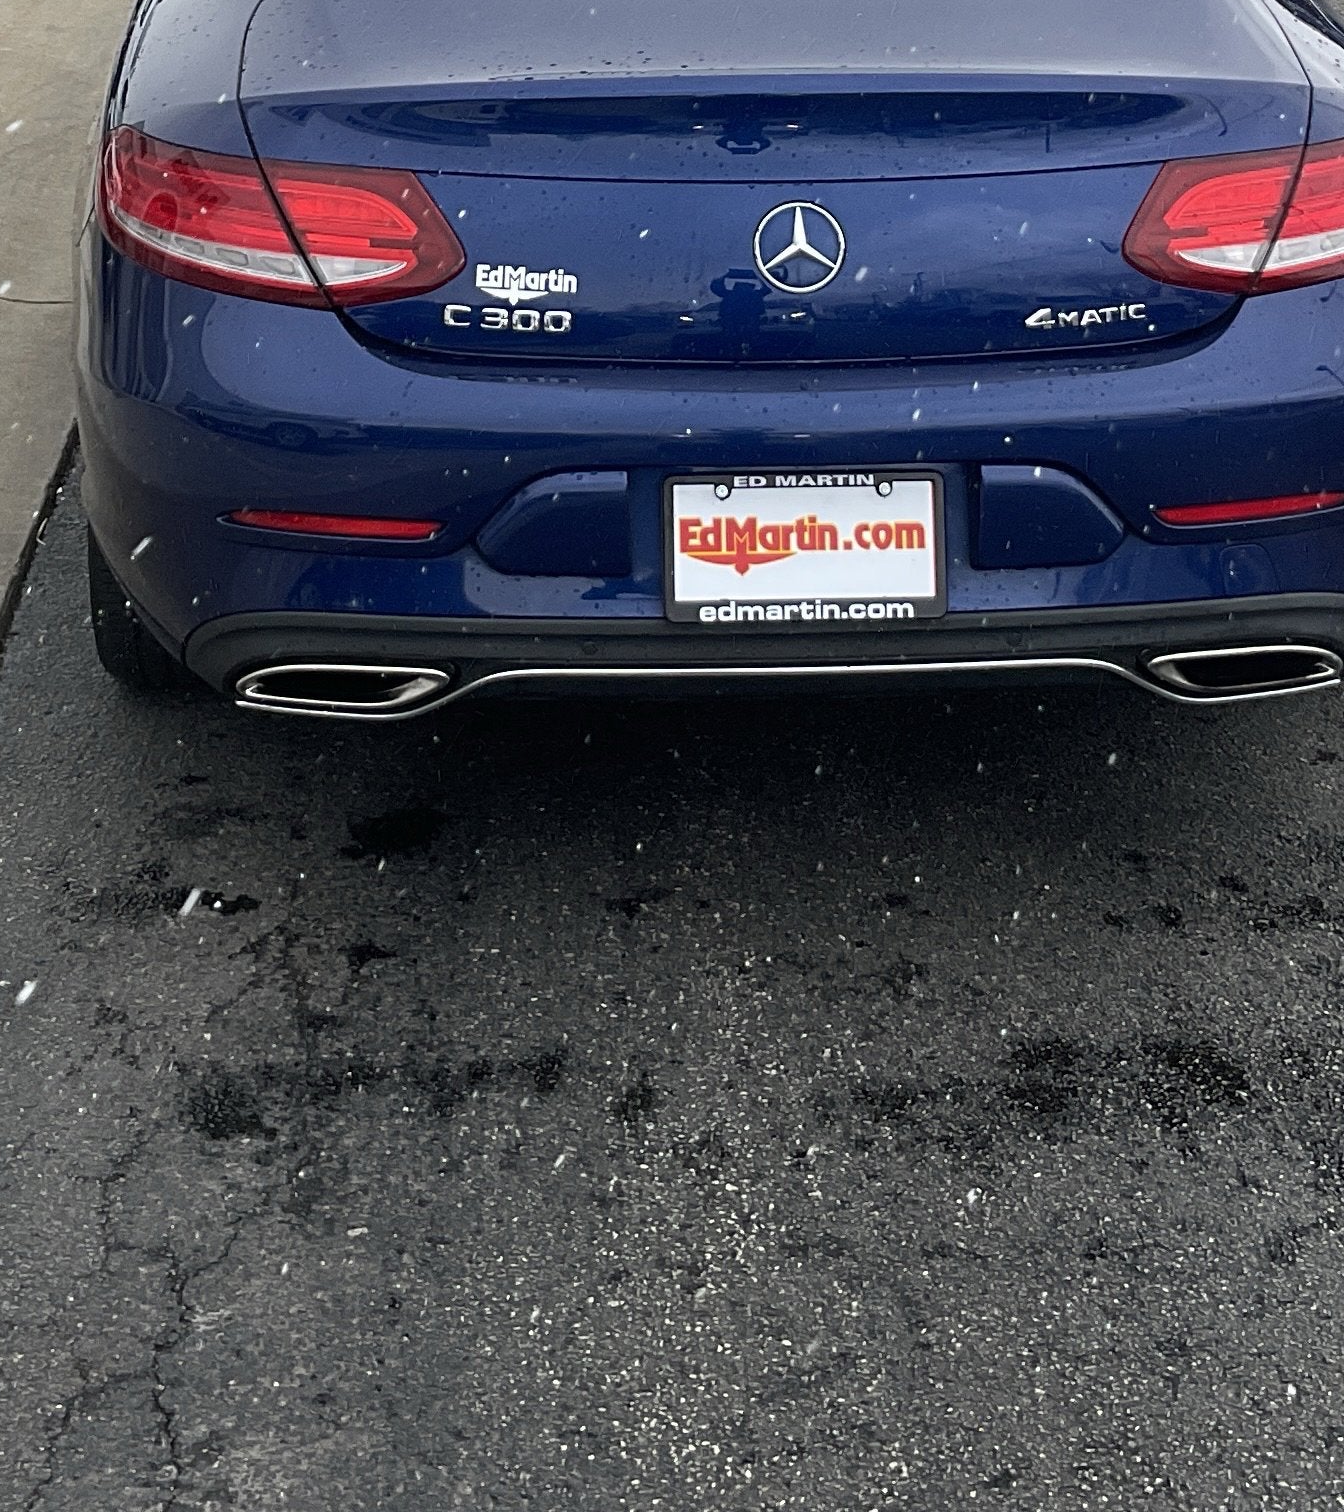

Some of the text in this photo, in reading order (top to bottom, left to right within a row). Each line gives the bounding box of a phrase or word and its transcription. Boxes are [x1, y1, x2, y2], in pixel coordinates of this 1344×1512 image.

[475, 264, 578, 295] EdMartin
[444, 304, 572, 333] C 300
[1025, 303, 1146, 329] 4MATIC
[733, 474, 875, 488] ED MARTIN
[678, 514, 926, 554] EdMartin.com
[699, 600, 915, 623] edmartin.com
